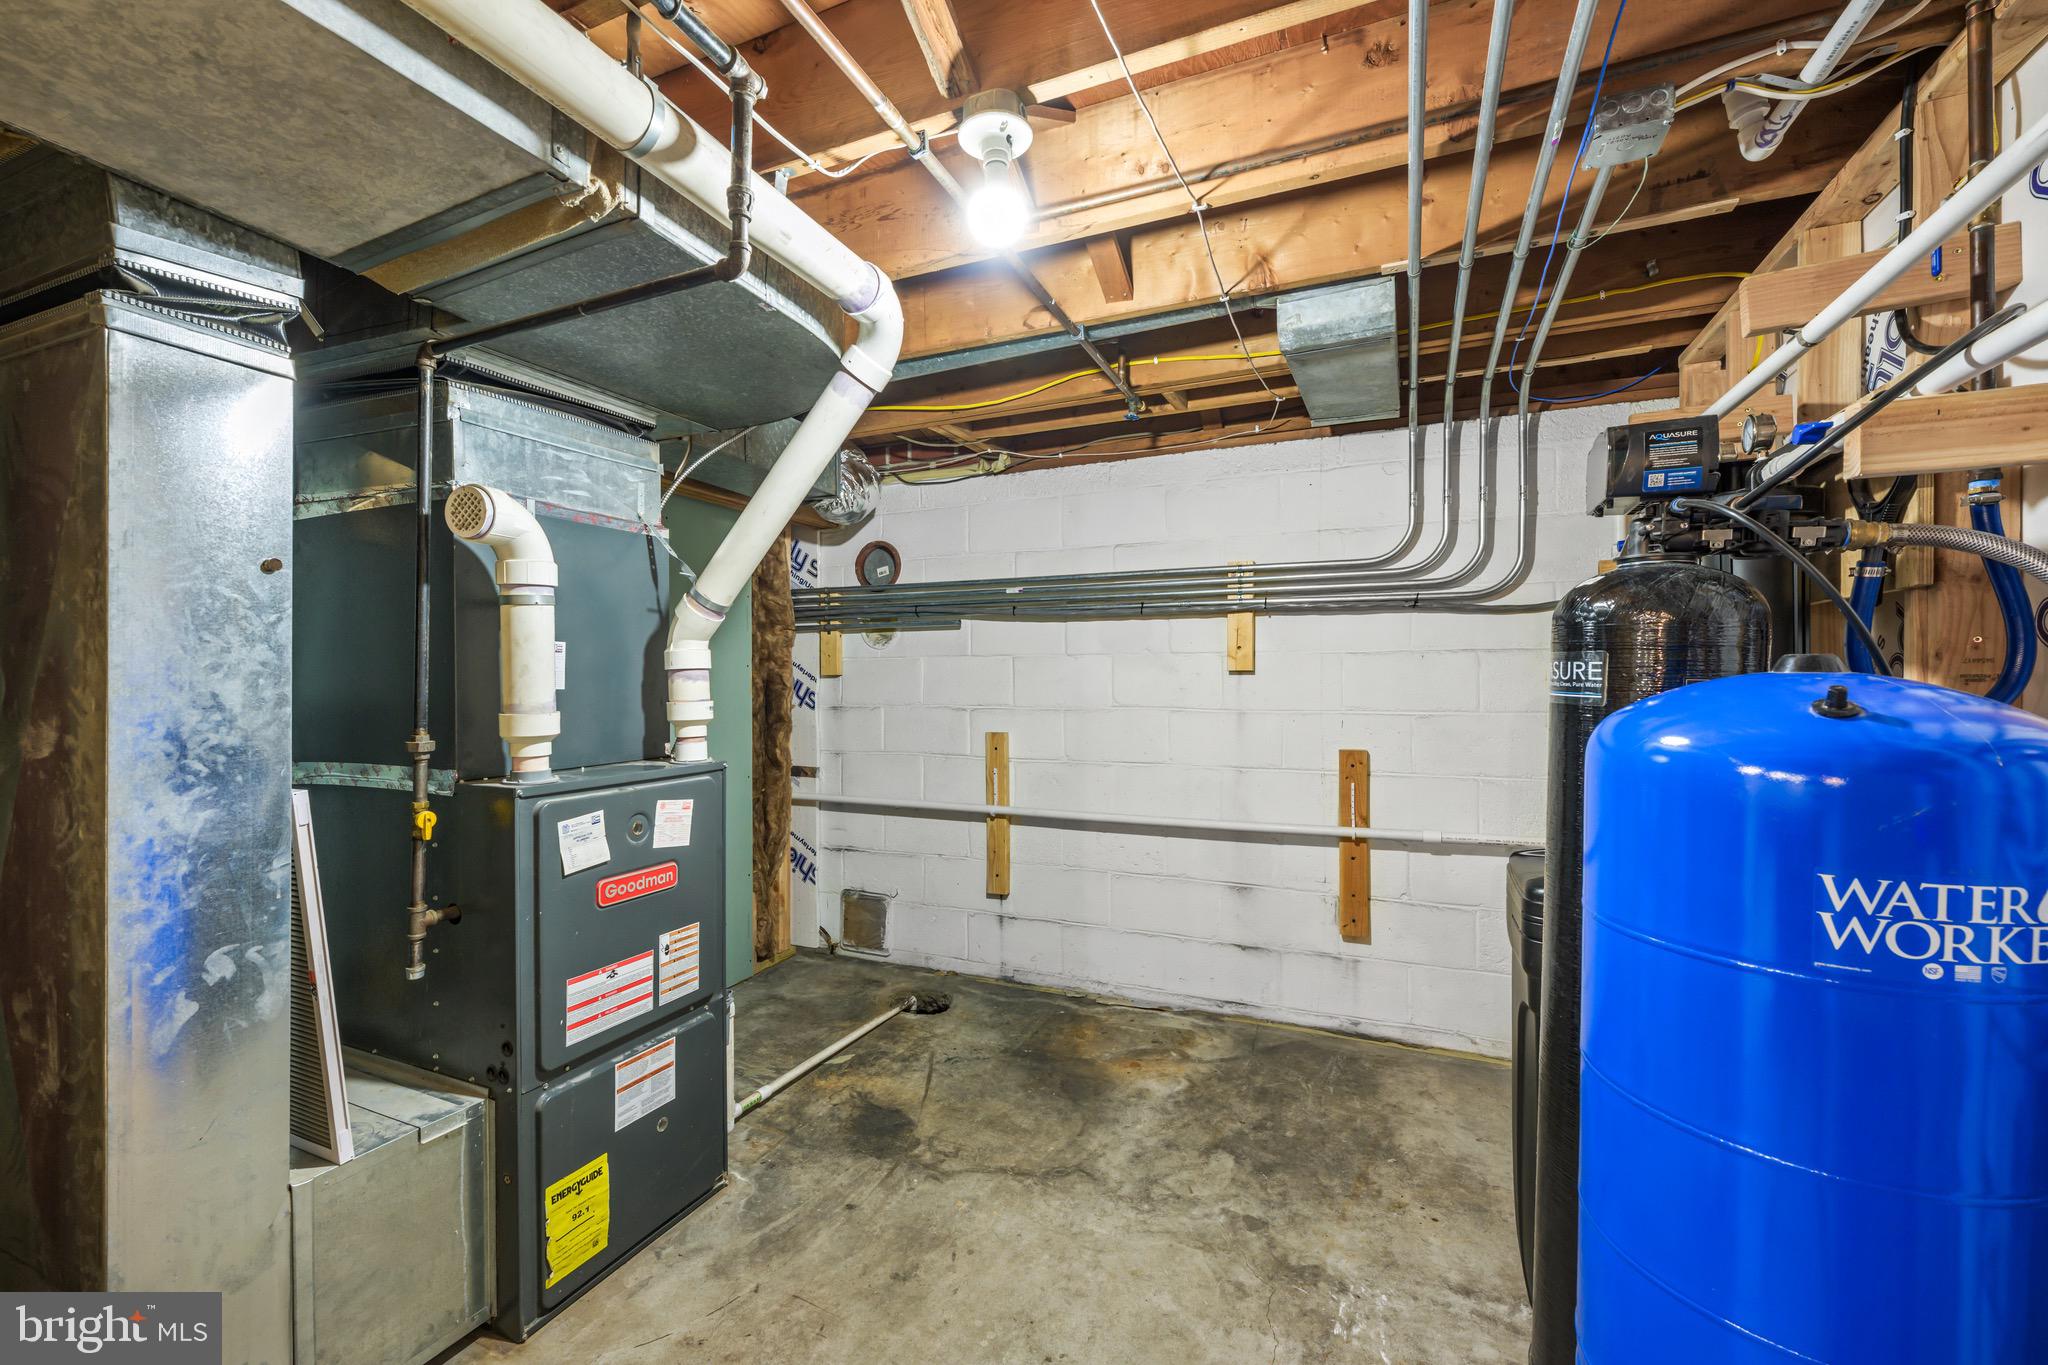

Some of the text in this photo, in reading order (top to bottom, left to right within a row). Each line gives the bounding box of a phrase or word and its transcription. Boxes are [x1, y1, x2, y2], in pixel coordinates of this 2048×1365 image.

[1649, 430, 1698, 440] AQUASURE
[1552, 661, 1603, 680] SURE
[605, 871, 674, 898] Goodman
[1816, 873, 2039, 925] WATER
[551, 1166, 603, 1205] ENERGYGUIDE
[571, 1205, 590, 1221] 92.1
